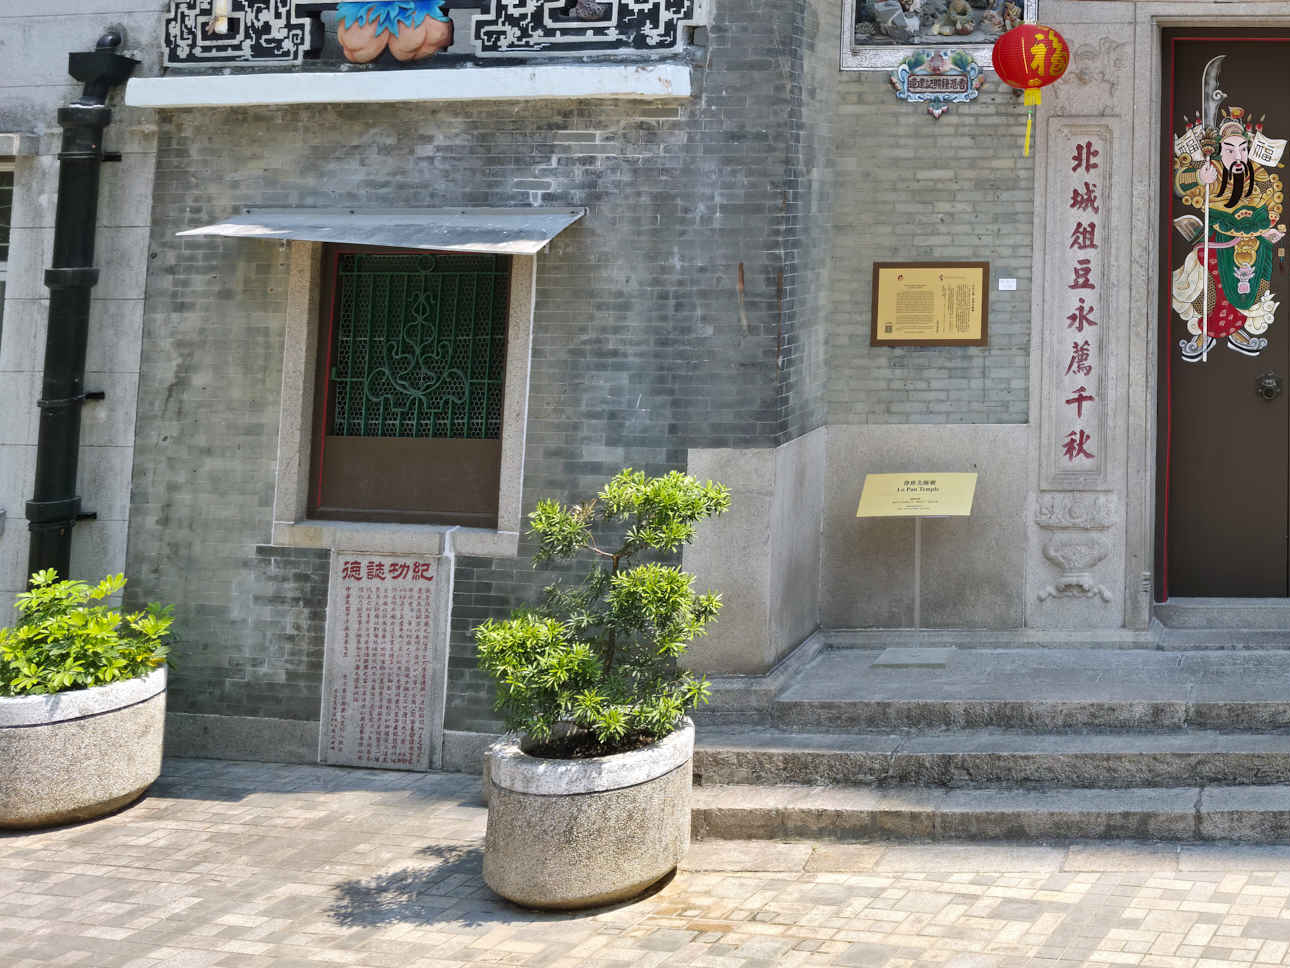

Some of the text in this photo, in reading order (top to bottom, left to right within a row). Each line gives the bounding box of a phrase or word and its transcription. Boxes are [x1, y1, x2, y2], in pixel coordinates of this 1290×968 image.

[1029, 29, 1067, 77] 福
[1063, 140, 1100, 462] 北城俎豆永薦千秋
